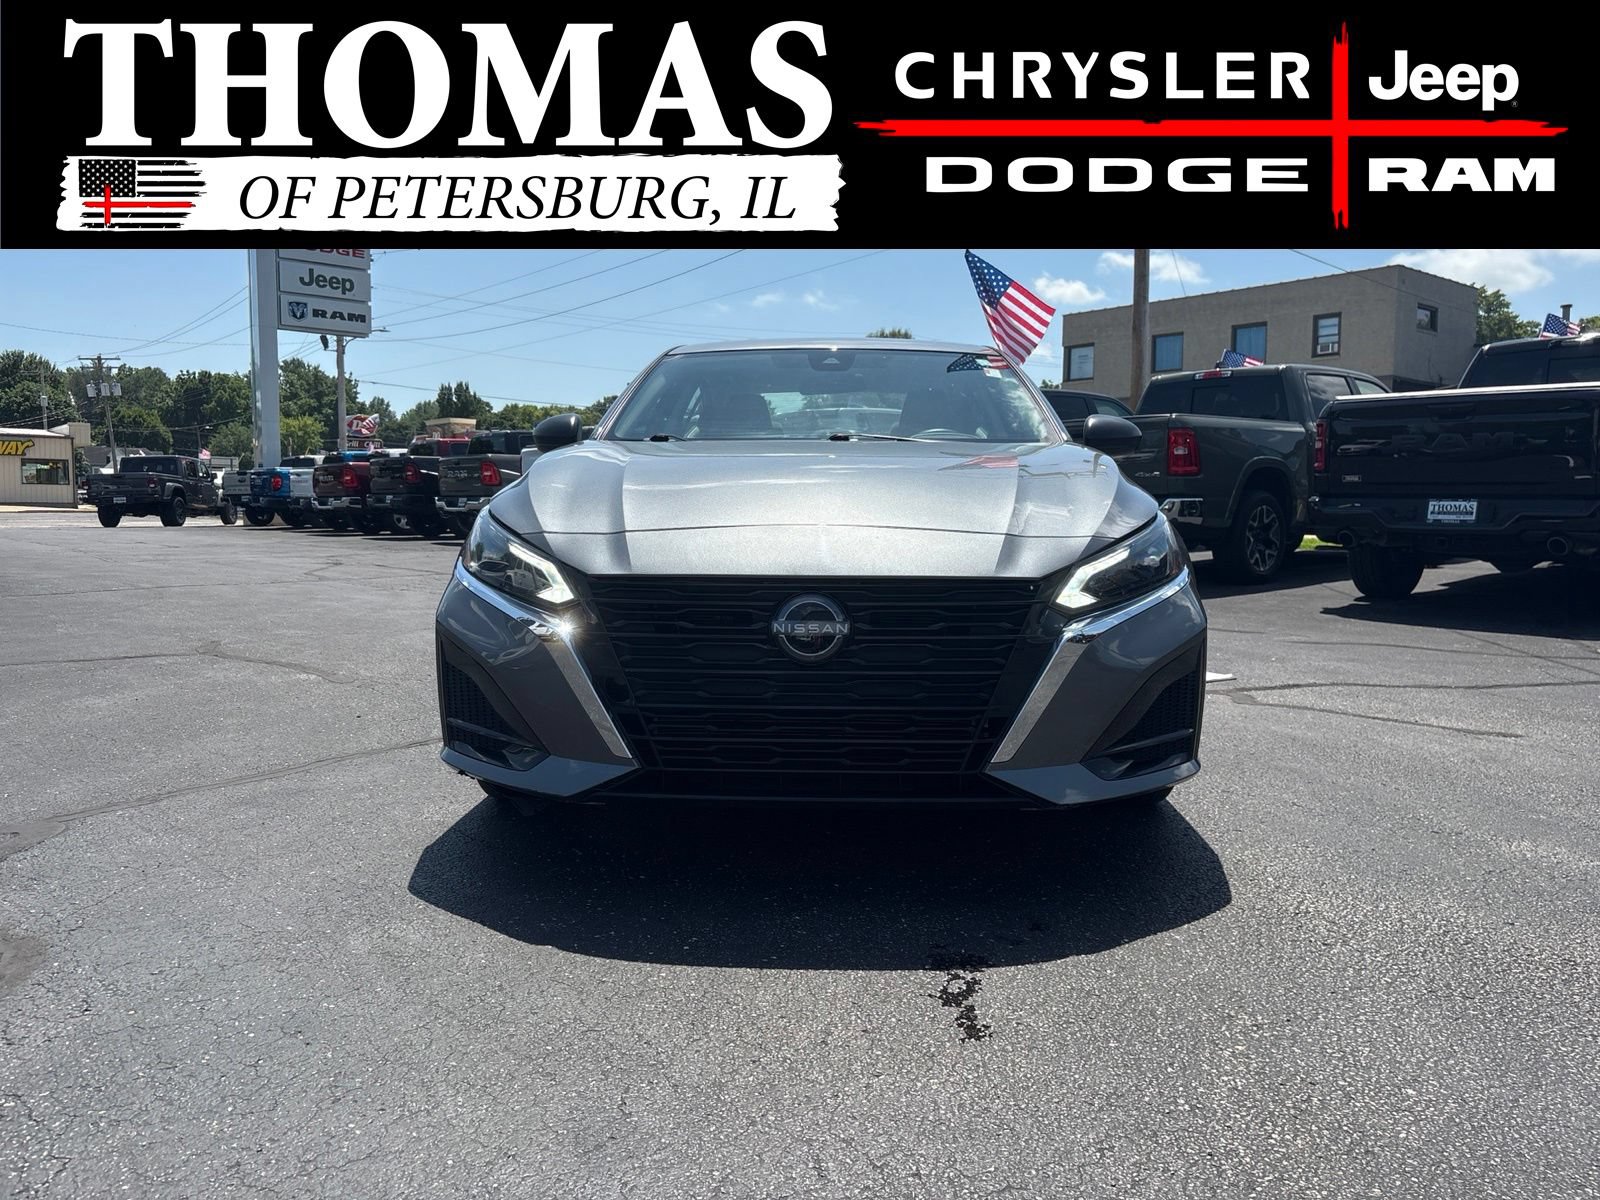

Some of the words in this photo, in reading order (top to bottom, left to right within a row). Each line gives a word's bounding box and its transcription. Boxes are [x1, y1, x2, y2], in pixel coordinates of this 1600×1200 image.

[299, 268, 355, 295] Jeep
[312, 308, 366, 323] RAM
[1392, 432, 1515, 449] RAM
[1431, 503, 1475, 512] THOMAS
[773, 623, 849, 634] NISSAN
